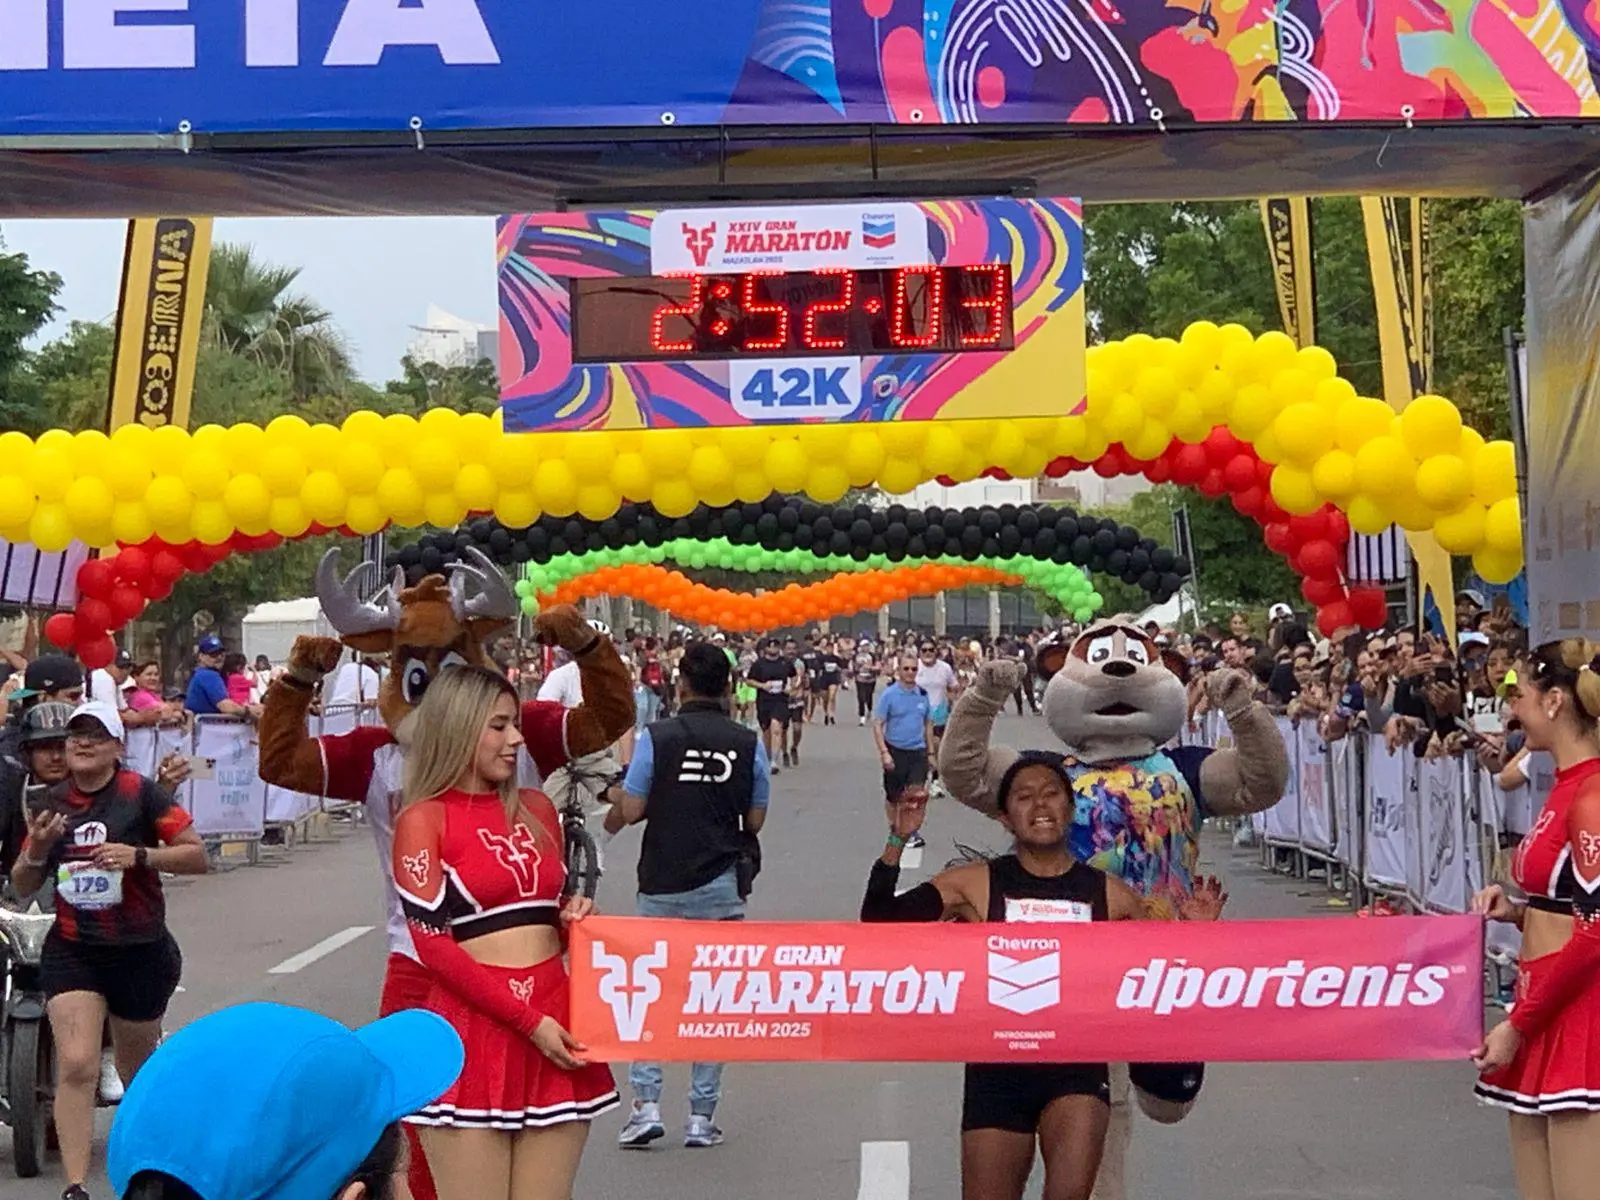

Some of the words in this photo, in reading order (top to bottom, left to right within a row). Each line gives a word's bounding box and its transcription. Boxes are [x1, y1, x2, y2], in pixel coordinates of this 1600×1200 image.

[728, 221, 762, 232] XXIV
[765, 220, 797, 231] GRAN
[724, 229, 852, 254] MARATÓN
[741, 366, 853, 407] 42K
[72, 876, 109, 893] 179
[987, 936, 1060, 951] Chevron
[692, 945, 768, 968] XXIV
[773, 944, 846, 966] GRAN
[683, 964, 965, 1014] MARATÓN
[1115, 958, 1450, 1015] dportenis
[677, 1018, 768, 1038] MAZATLÁN
[770, 1021, 811, 1038] 2025
